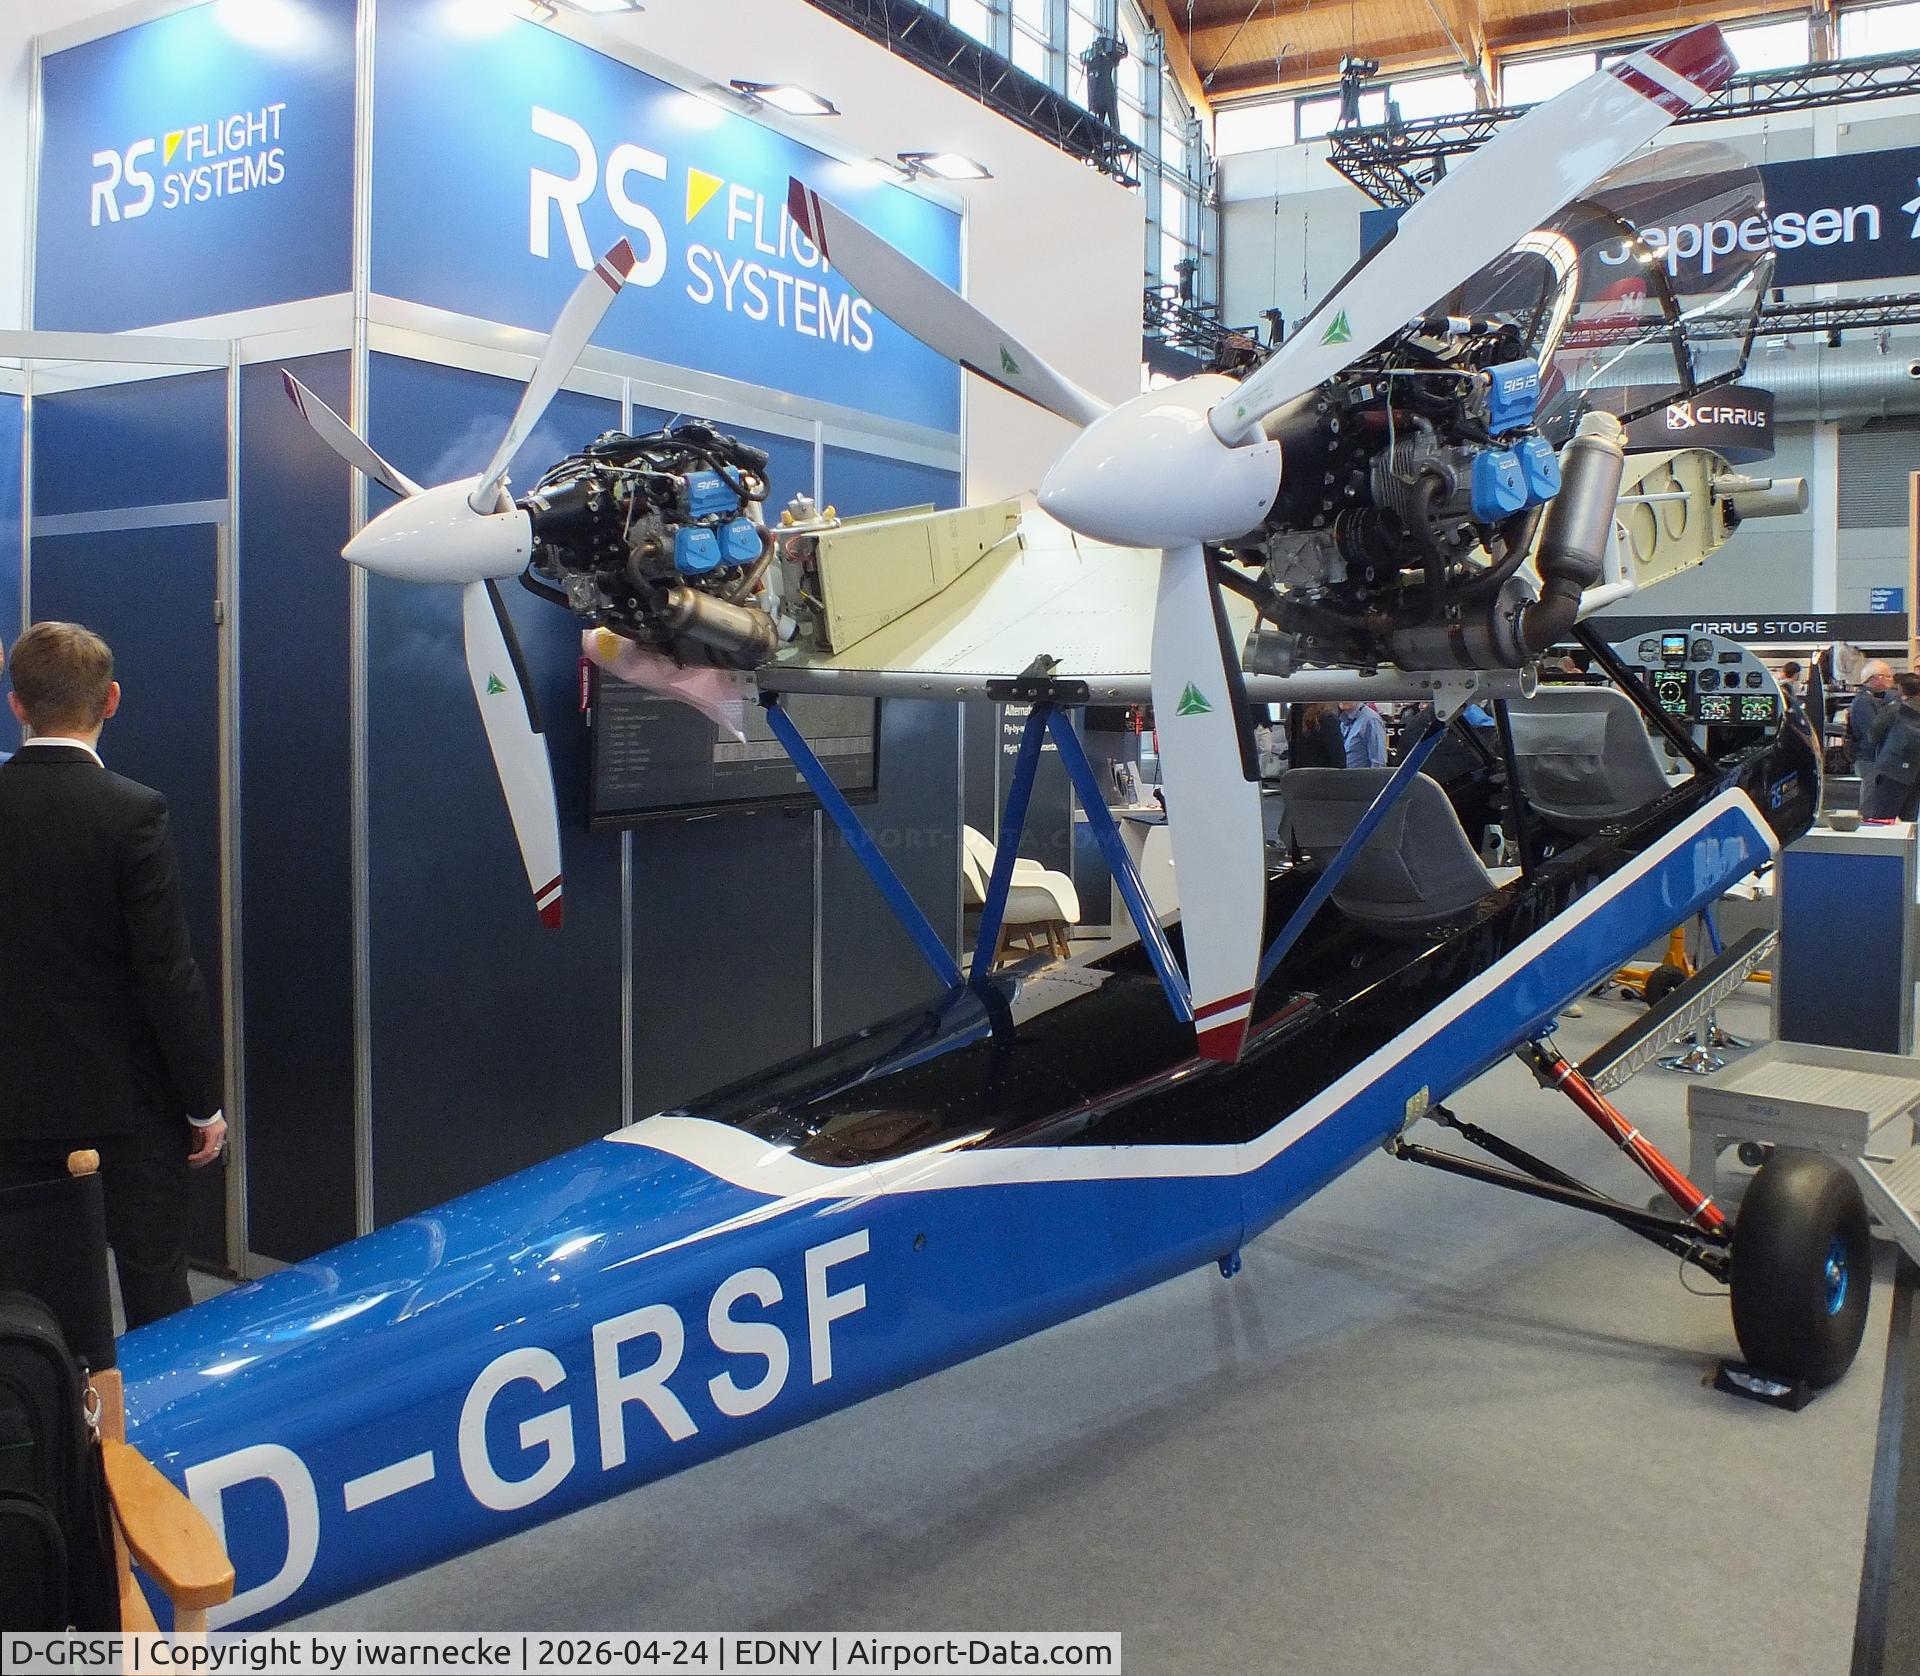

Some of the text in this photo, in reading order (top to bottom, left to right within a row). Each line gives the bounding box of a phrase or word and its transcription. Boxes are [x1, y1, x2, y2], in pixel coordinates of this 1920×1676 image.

[187, 103, 286, 162] FLIGHT
[91, 138, 155, 226] RS
[163, 148, 285, 209] SYSTEMS
[530, 105, 668, 288] RS
[727, 183, 830, 273] FLIG
[686, 244, 874, 352] SYSTEMS
[1695, 405, 1767, 428] CIRRUS
[1691, 621, 1828, 634] CIRRUS STORE
[183, 1230, 871, 1631] D-GRSF
